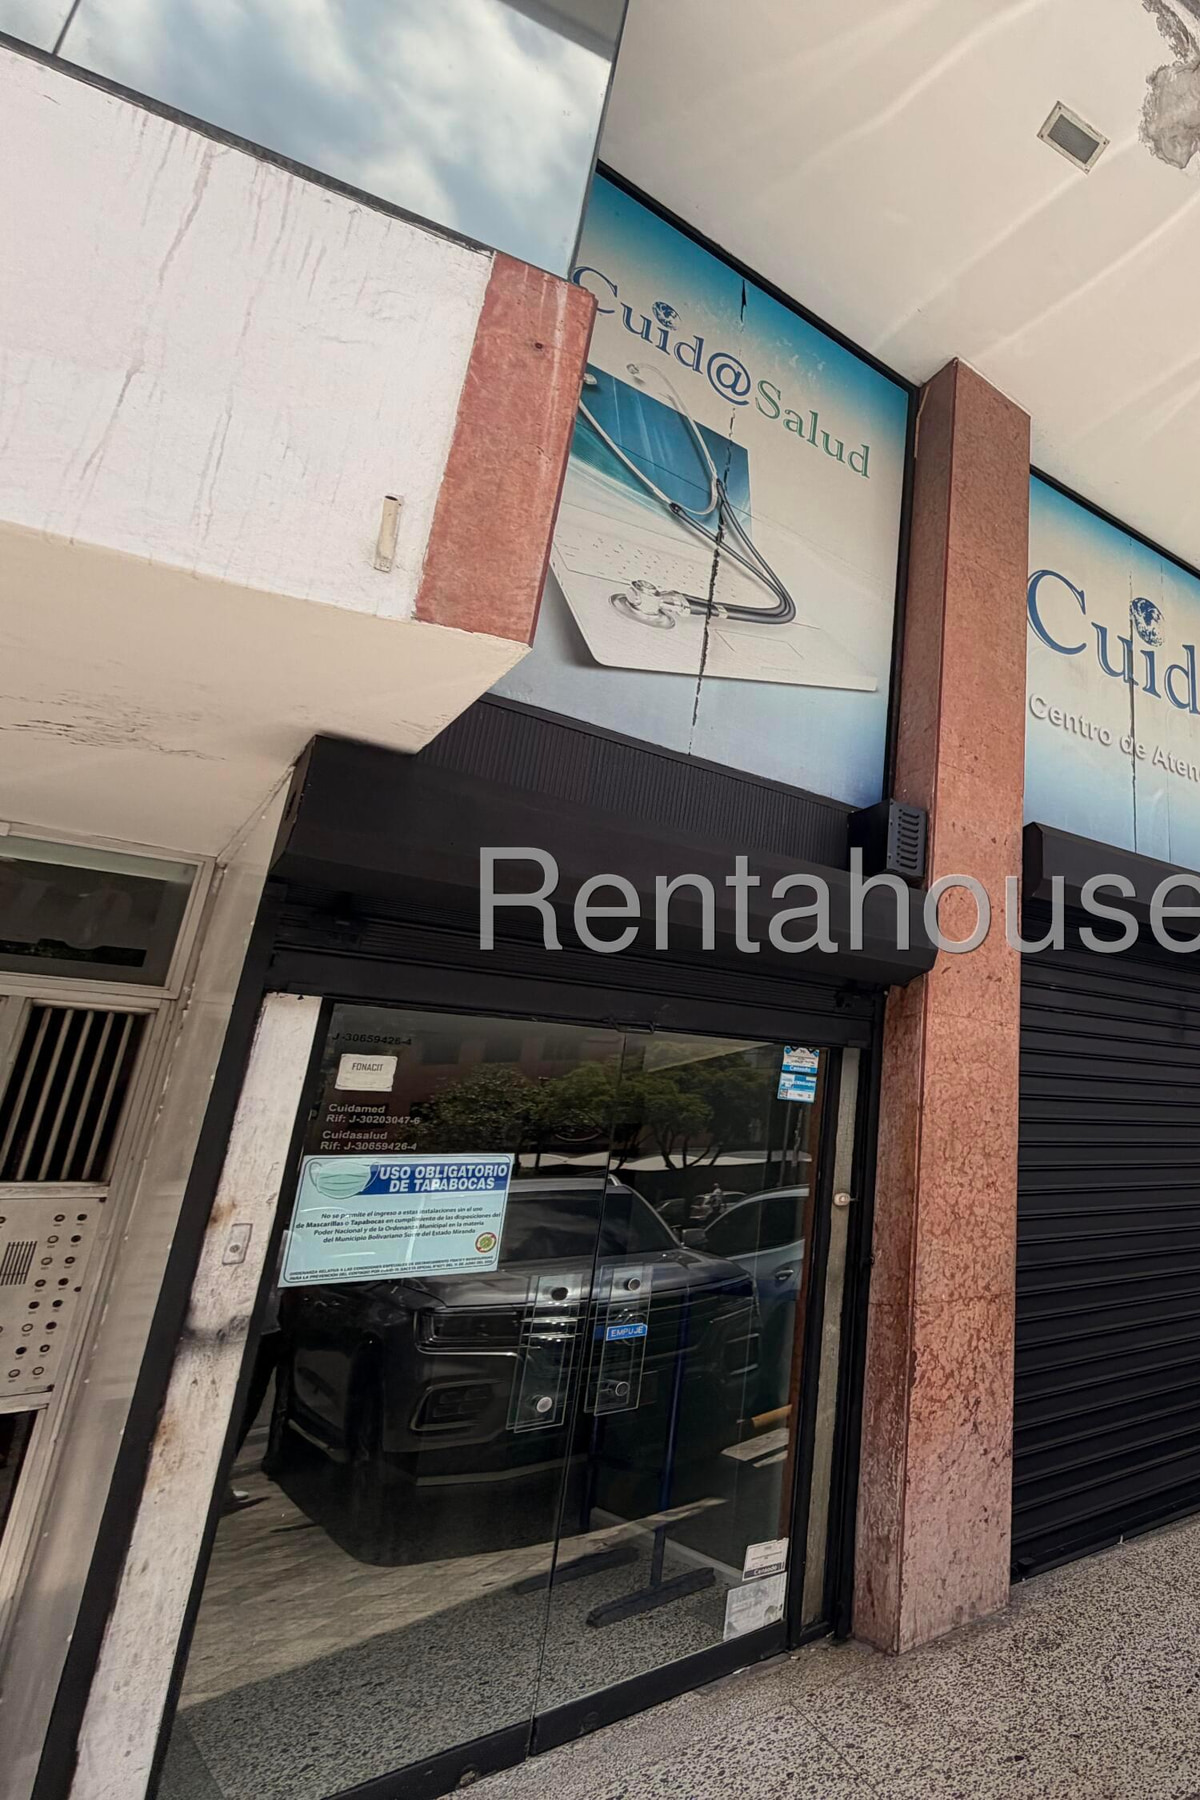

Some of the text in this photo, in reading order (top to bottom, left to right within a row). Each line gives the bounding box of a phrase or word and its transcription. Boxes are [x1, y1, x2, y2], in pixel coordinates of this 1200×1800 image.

[1030, 692, 1113, 746] Centro
[1119, 733, 1147, 760] de
[352, 1062, 383, 1072] FONACIT
[328, 1103, 386, 1114] Cuidamed
[326, 1114, 421, 1125] Rif: J-30203047-6
[322, 1130, 388, 1140] Cuidasalud
[320, 1141, 417, 1151] Rif: J-30659426-4
[380, 1164, 508, 1180] USO OBLIGATORIO
[389, 1177, 495, 1193] DE TAPABOCAS
[306, 1220, 343, 1228] Mascarillas
[351, 1218, 384, 1226] Tapabocas
[394, 1216, 436, 1224] cumpliiento
[454, 1213, 491, 1221] disposiciones
[340, 1211, 366, 1220] pmite
[374, 1210, 397, 1218] ingreso
[419, 1222, 448, 1230] Municipal
[335, 1234, 367, 1242] Municipio
[368, 1232, 403, 1240] Bolivariano
[611, 1325, 643, 1337] EMPUJE
